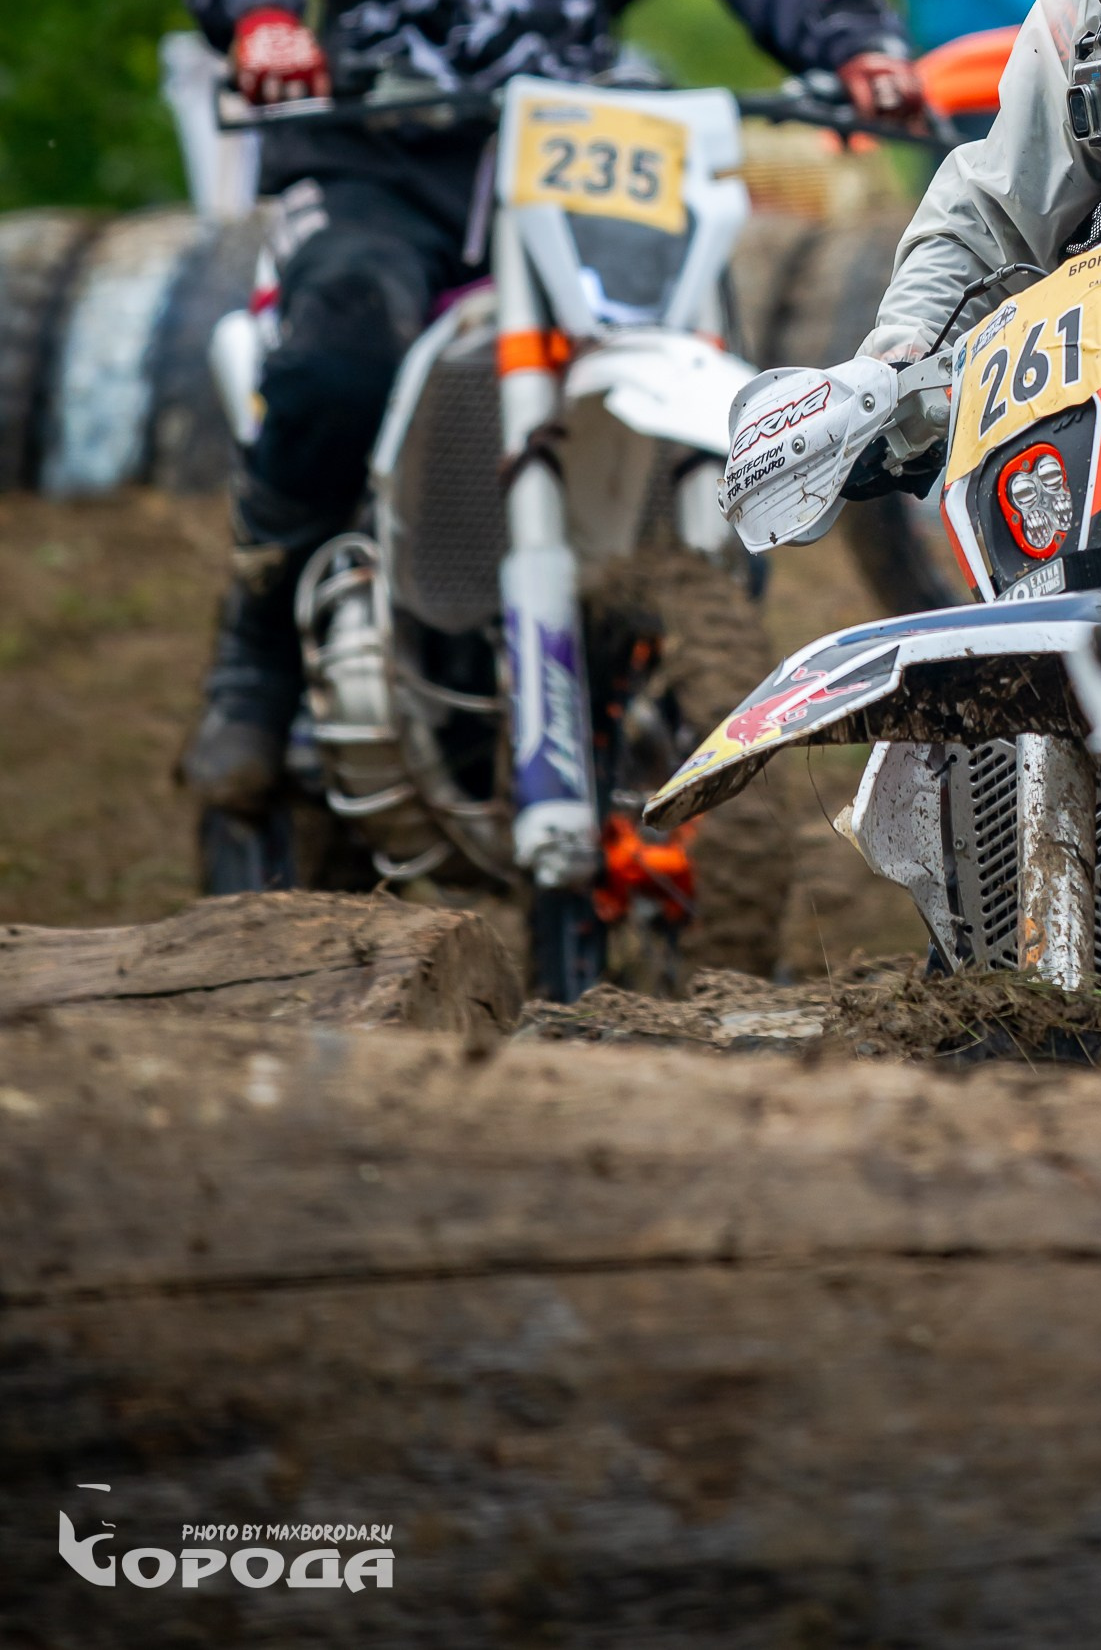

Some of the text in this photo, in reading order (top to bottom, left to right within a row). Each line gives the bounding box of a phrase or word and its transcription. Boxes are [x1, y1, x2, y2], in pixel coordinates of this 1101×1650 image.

[541, 136, 664, 202] 235
[979, 304, 1083, 440] 261
[726, 456, 786, 502] FOR ENDURO
[727, 442, 784, 487] PROTECTION
